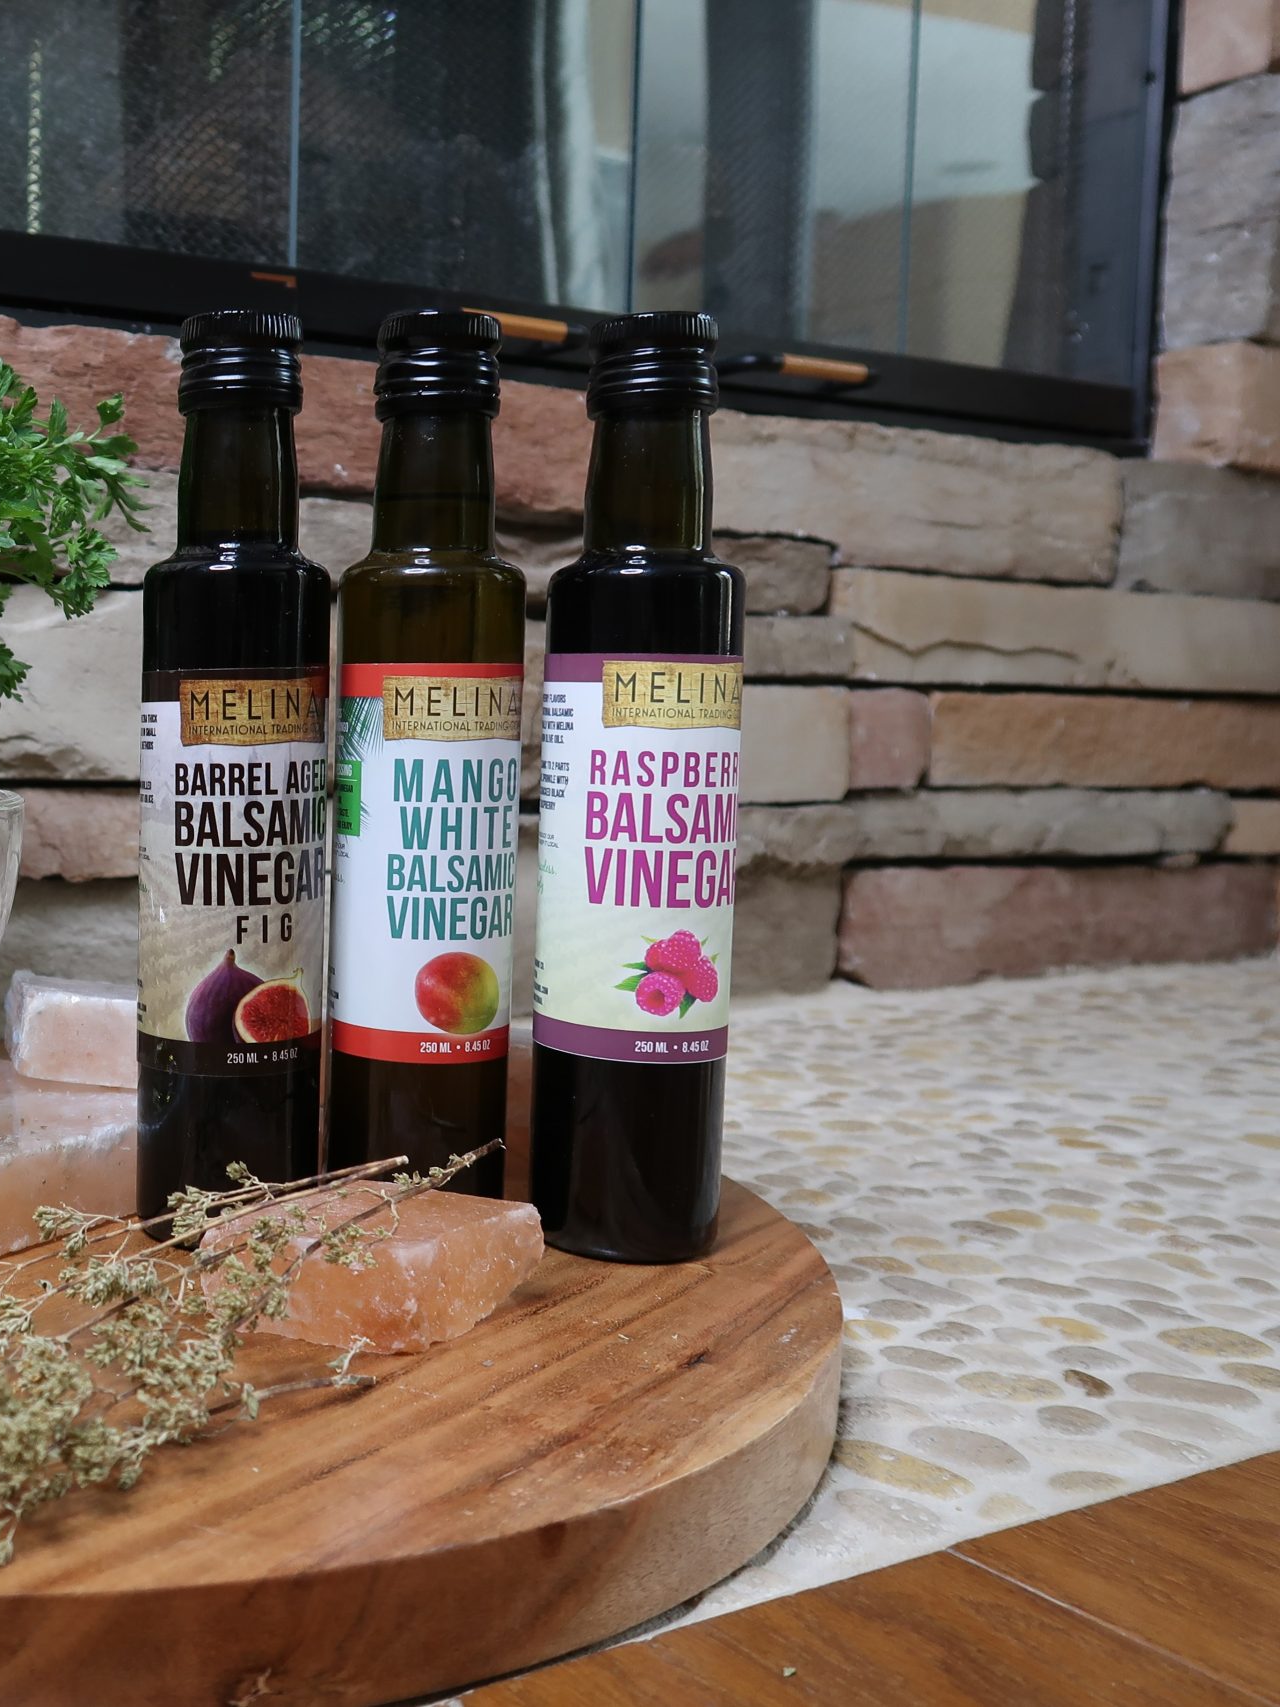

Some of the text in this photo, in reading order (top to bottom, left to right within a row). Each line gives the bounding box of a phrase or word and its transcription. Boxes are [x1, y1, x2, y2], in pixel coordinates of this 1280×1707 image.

[394, 686, 520, 717] MELINA
[614, 671, 740, 704] MELINA
[190, 688, 320, 721] MELINA
[612, 708, 696, 719] INTERNATIONAL
[699, 708, 732, 719] TRADING
[189, 724, 269, 736] INTERNATIONAL
[271, 723, 308, 735] TRADING
[392, 720, 471, 731] INTERNATIONAL
[473, 720, 509, 731] TRADING
[174, 759, 326, 796] BARREL AGED
[393, 758, 517, 803] MANGO
[174, 796, 326, 847] BALSAMIC
[400, 805, 513, 851] WHITE
[585, 791, 737, 844] BALSAMI
[174, 847, 324, 906] VINEGAR
[387, 851, 515, 893] BALSAMIC
[236, 913, 292, 944] FIG
[387, 893, 513, 941] VINEGAR
[226, 1053, 245, 1064] 250
[247, 1053, 259, 1064] ML
[272, 1049, 289, 1061] 8.45
[420, 1039, 490, 1053] 250 ML 8.45 OZ
[634, 1040, 709, 1053] 250 ML 8.45 OZ
